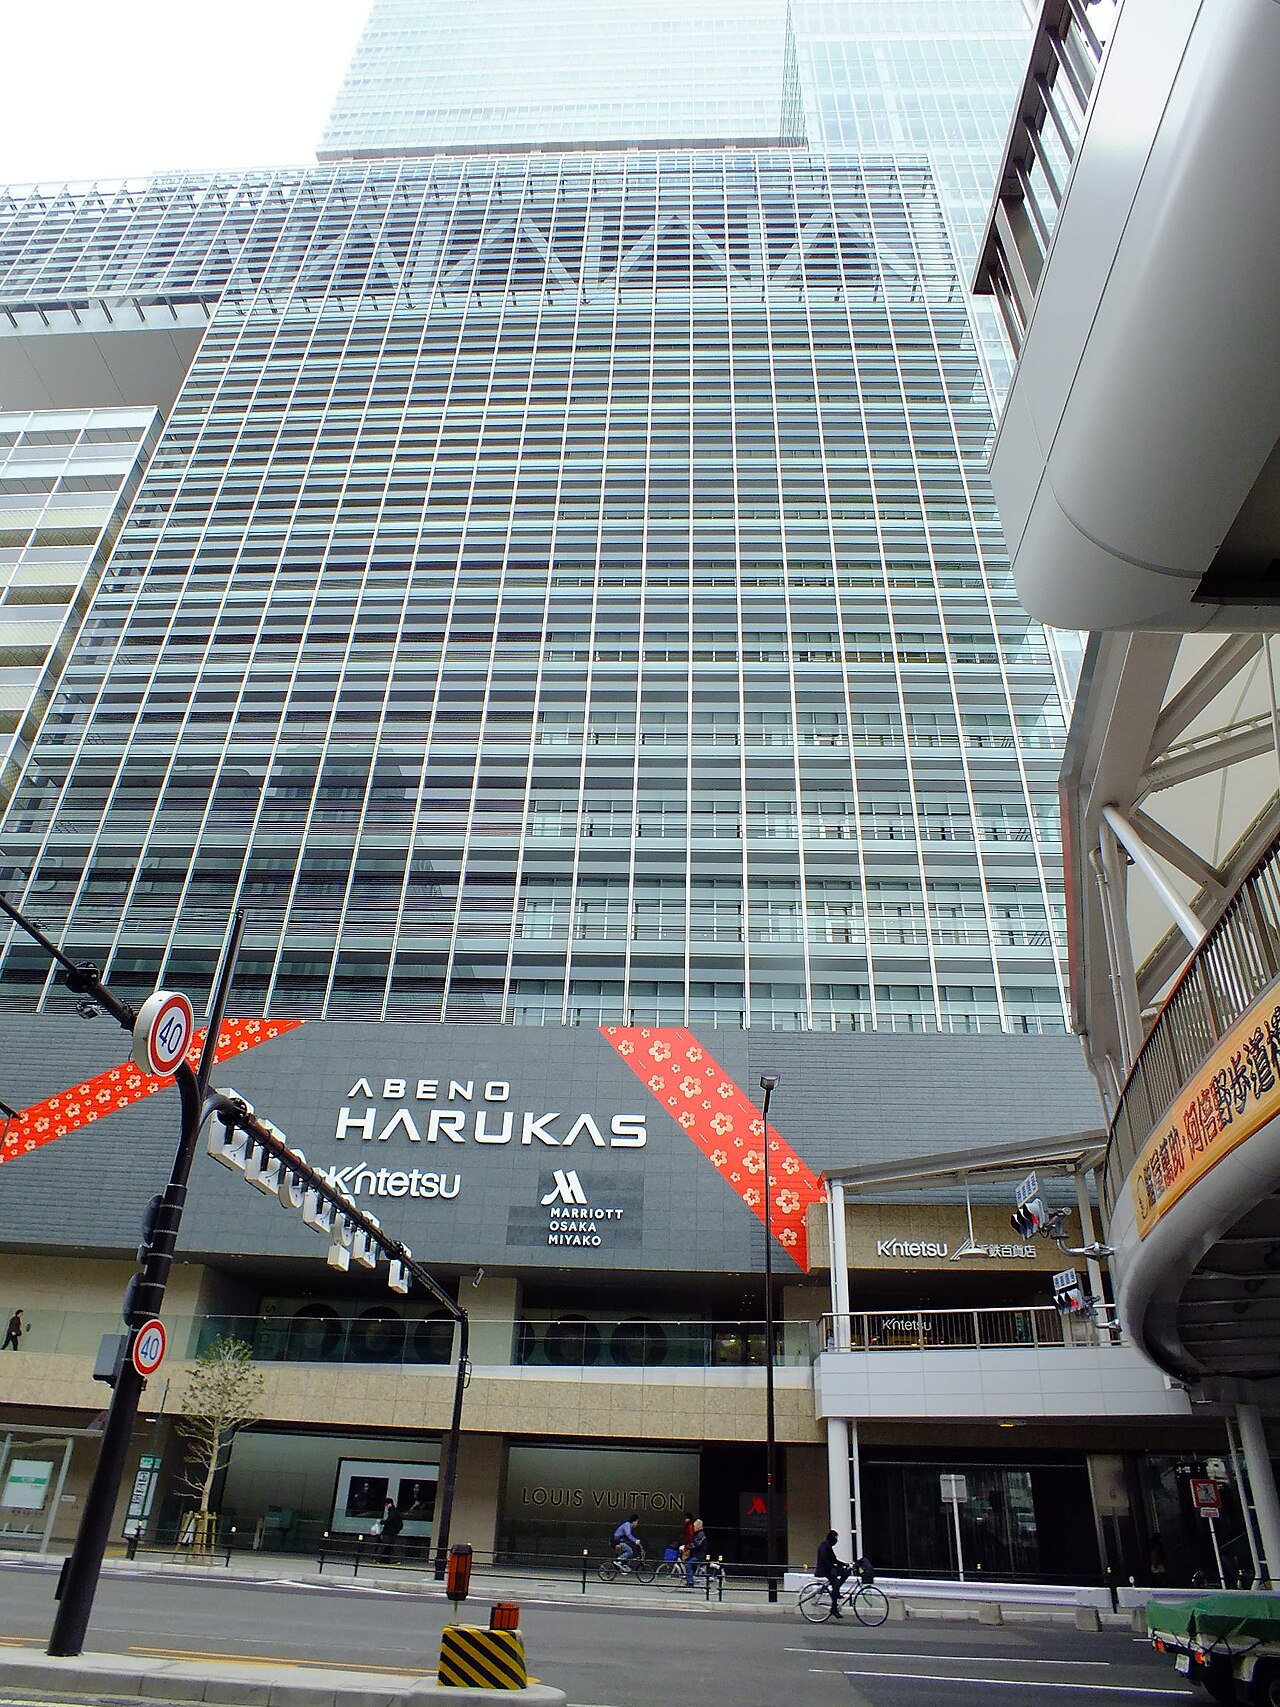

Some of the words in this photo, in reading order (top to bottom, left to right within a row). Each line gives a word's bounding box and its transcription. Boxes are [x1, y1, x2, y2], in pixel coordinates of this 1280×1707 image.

[159, 1016, 183, 1054] 40
[347, 1077, 510, 1101] ABENO
[335, 1106, 647, 1147] HARUKAS
[550, 1207, 624, 1220] MARRIOTT
[549, 1220, 597, 1233] OSAKA
[548, 1234, 602, 1247] MIYAKO
[877, 1237, 948, 1257] Kintetsu
[140, 1335, 160, 1361] 40
[522, 1486, 584, 1507] LOUIS
[592, 1489, 685, 1512] VUITTON
